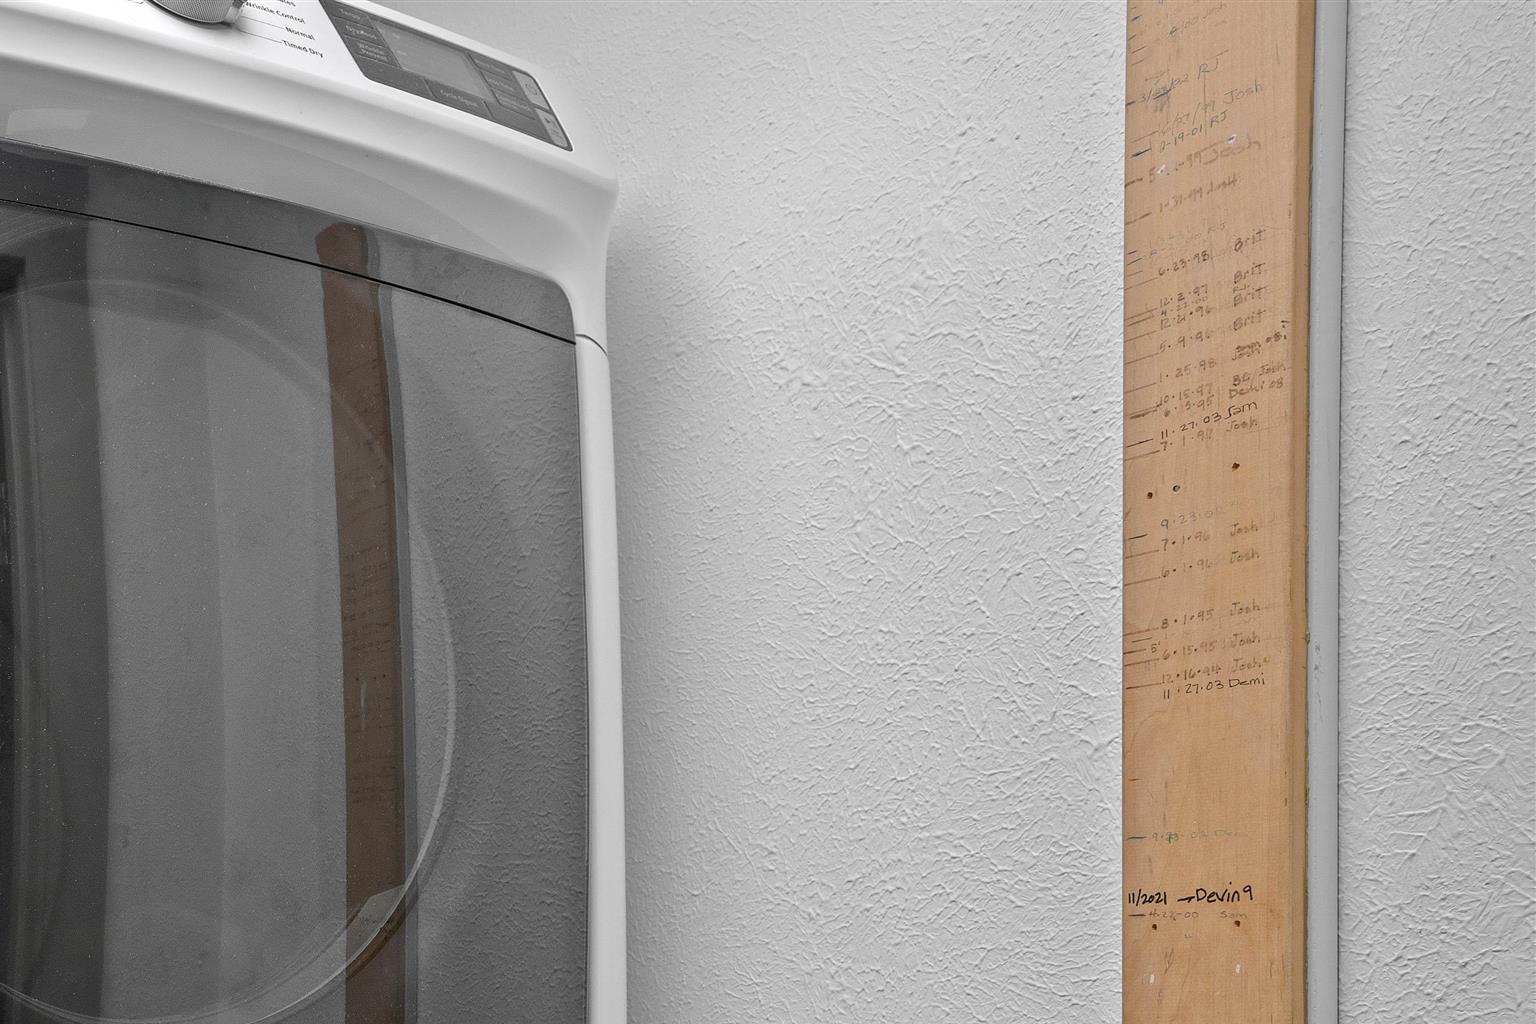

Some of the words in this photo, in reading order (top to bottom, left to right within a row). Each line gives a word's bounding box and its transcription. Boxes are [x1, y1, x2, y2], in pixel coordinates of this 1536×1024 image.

[285, 26, 315, 41] Normal
[282, 39, 308, 52] Timed
[308, 48, 324, 58] Dry
[1228, 671, 1265, 688] Demi
[1127, 889, 1168, 905] 11/2021
[1195, 881, 1240, 904] Devin
[1243, 884, 1254, 901] 9
